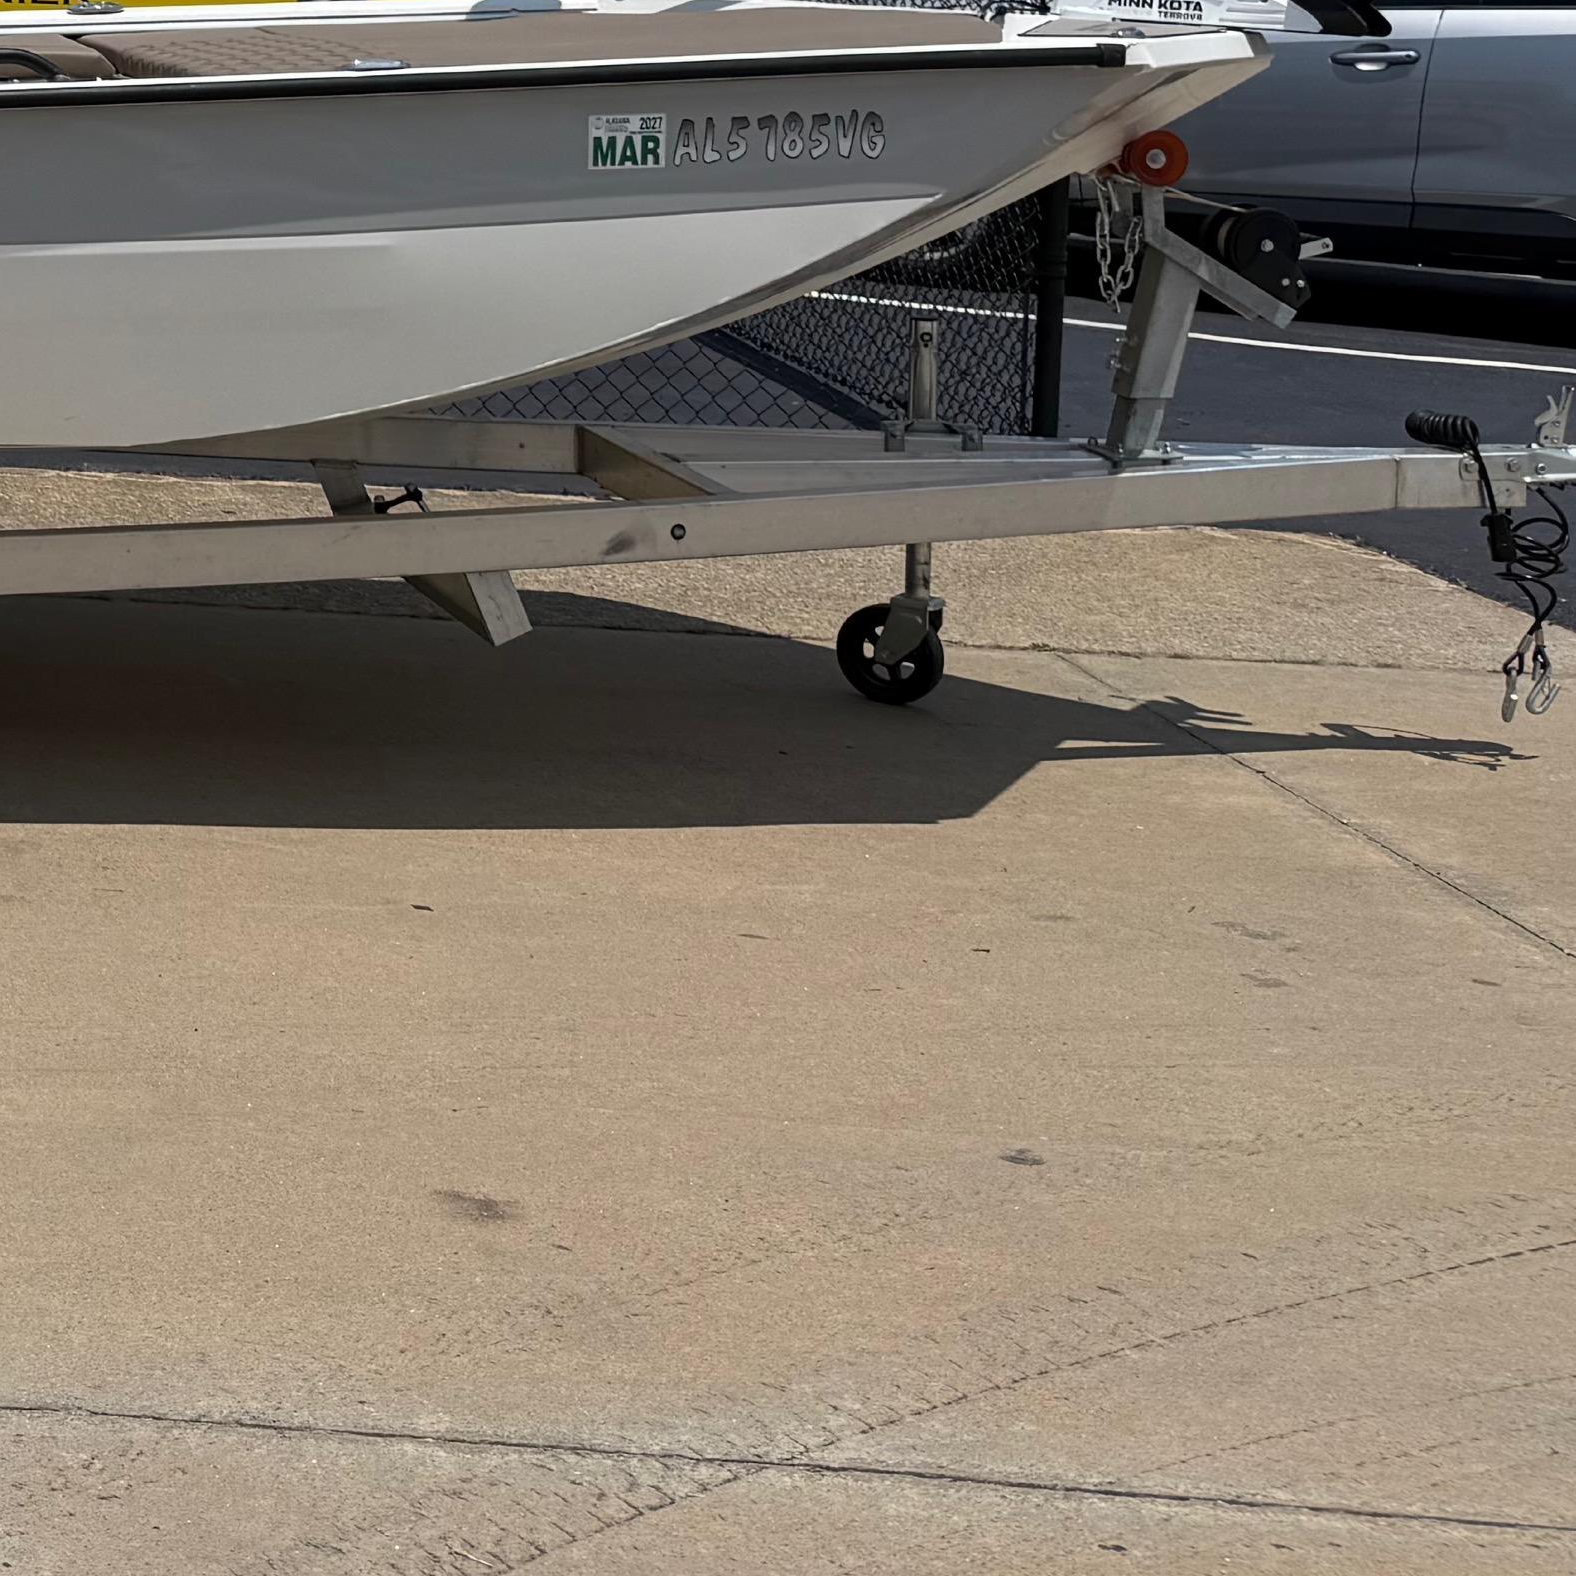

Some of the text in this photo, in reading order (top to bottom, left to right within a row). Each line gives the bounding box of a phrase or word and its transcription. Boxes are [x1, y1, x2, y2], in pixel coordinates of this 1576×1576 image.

[1158, 0, 1203, 12] KOTA
[639, 116, 663, 130] 2027
[592, 135, 661, 167] MAR
